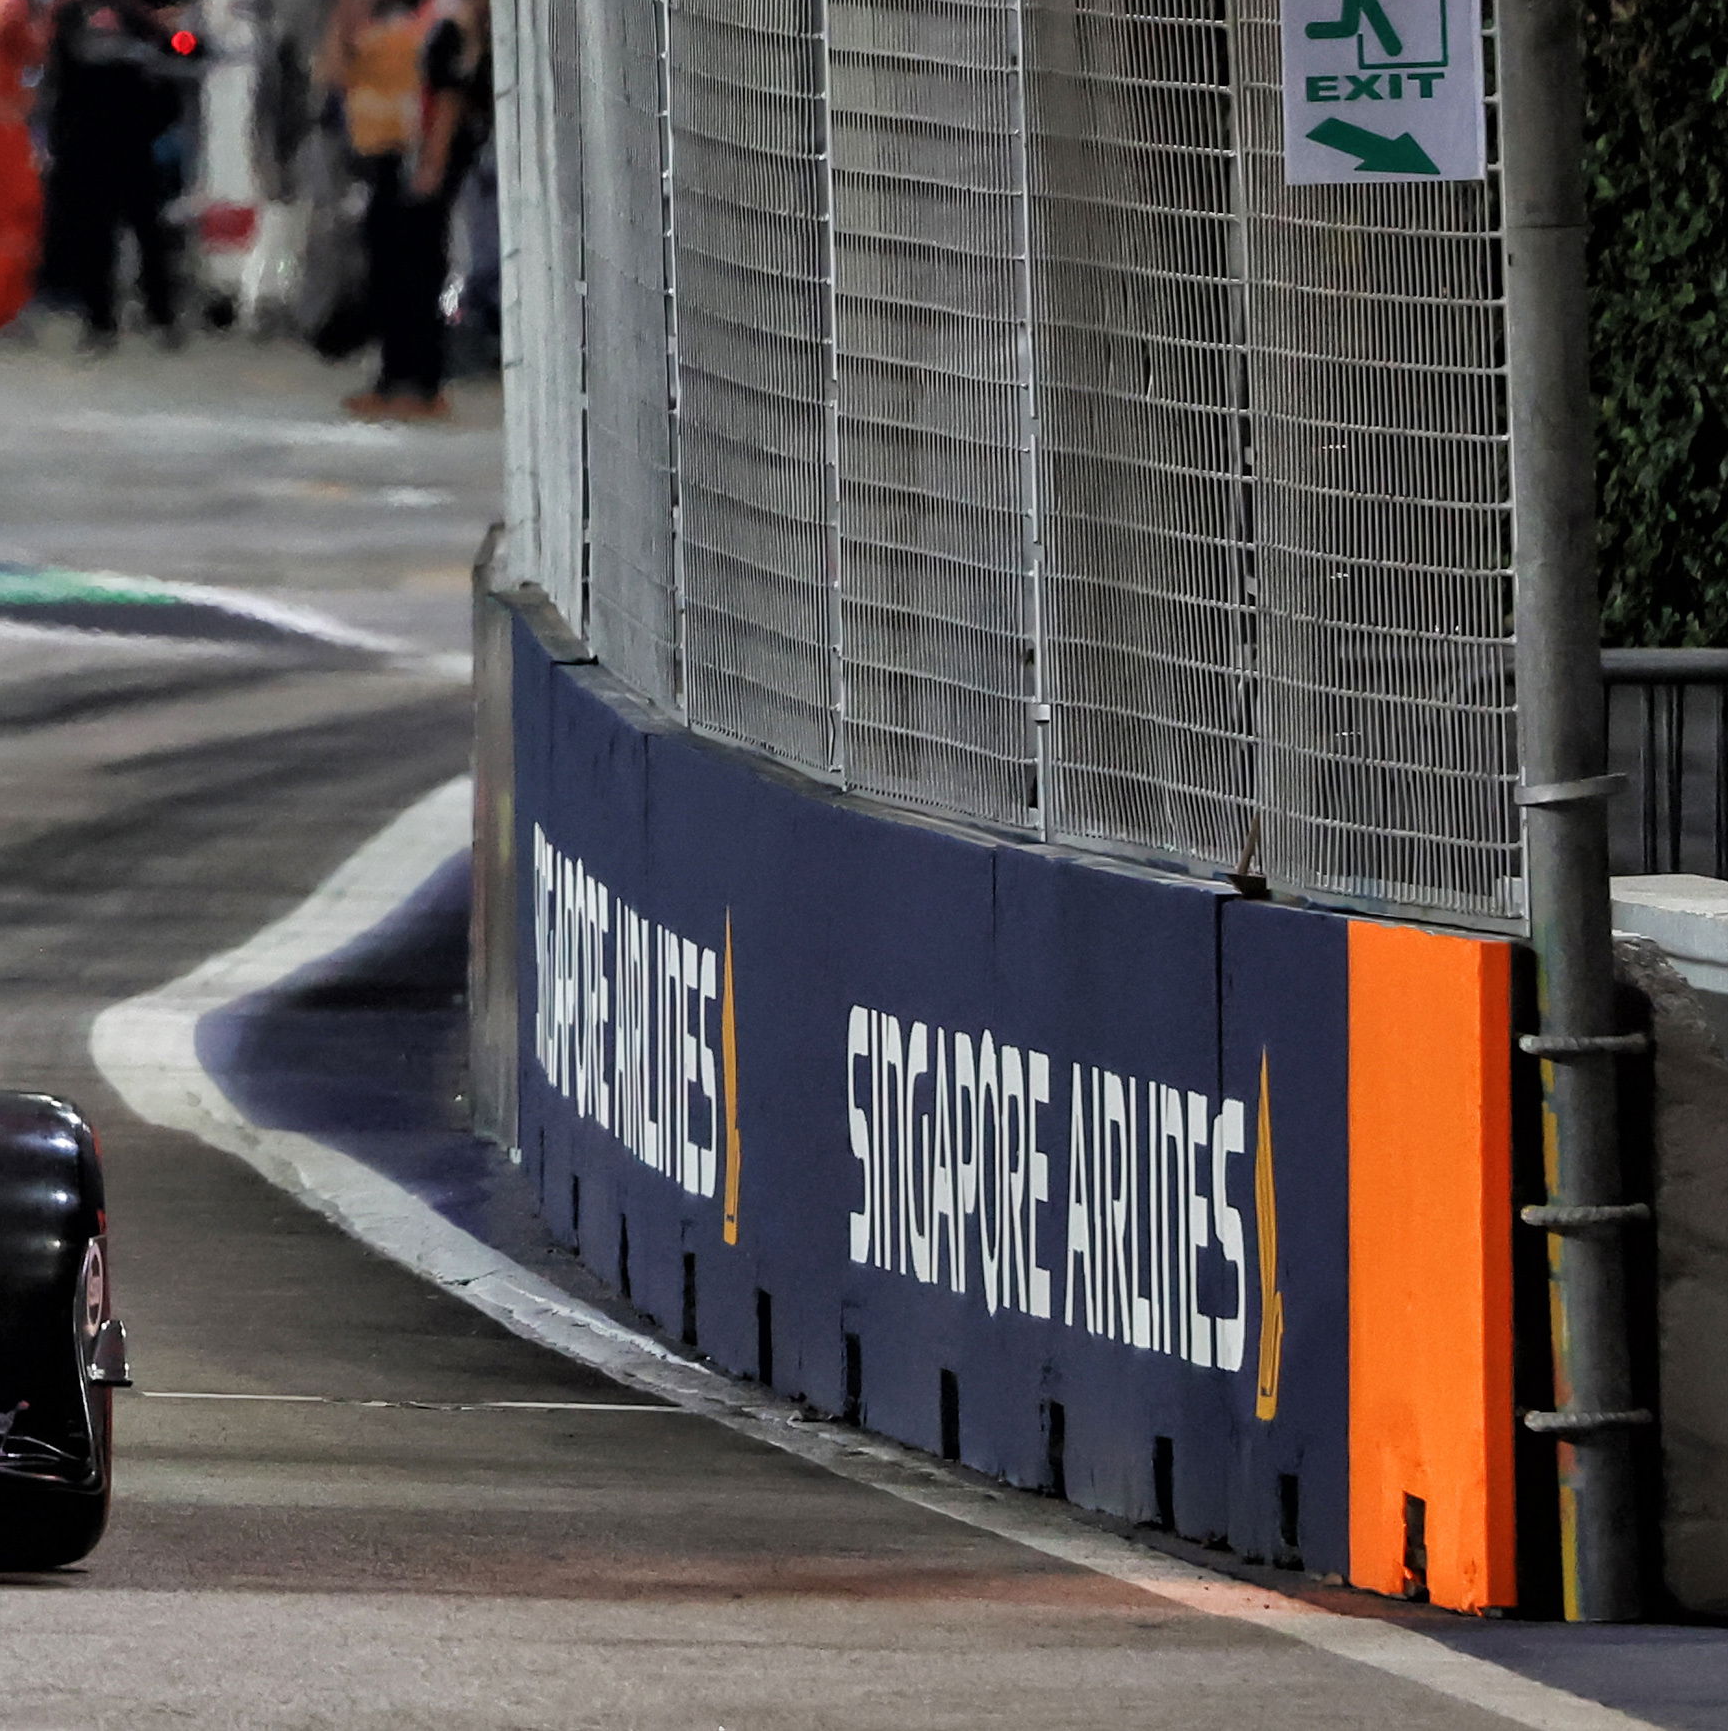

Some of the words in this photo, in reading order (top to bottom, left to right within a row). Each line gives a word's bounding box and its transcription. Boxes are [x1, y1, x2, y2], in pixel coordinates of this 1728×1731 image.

[1305, 71, 1445, 102] EXIT
[614, 896, 716, 1198] AIRLINES
[847, 1004, 1051, 1320] SINGAPORE
[1064, 1061, 1245, 1373] AIRLINES
